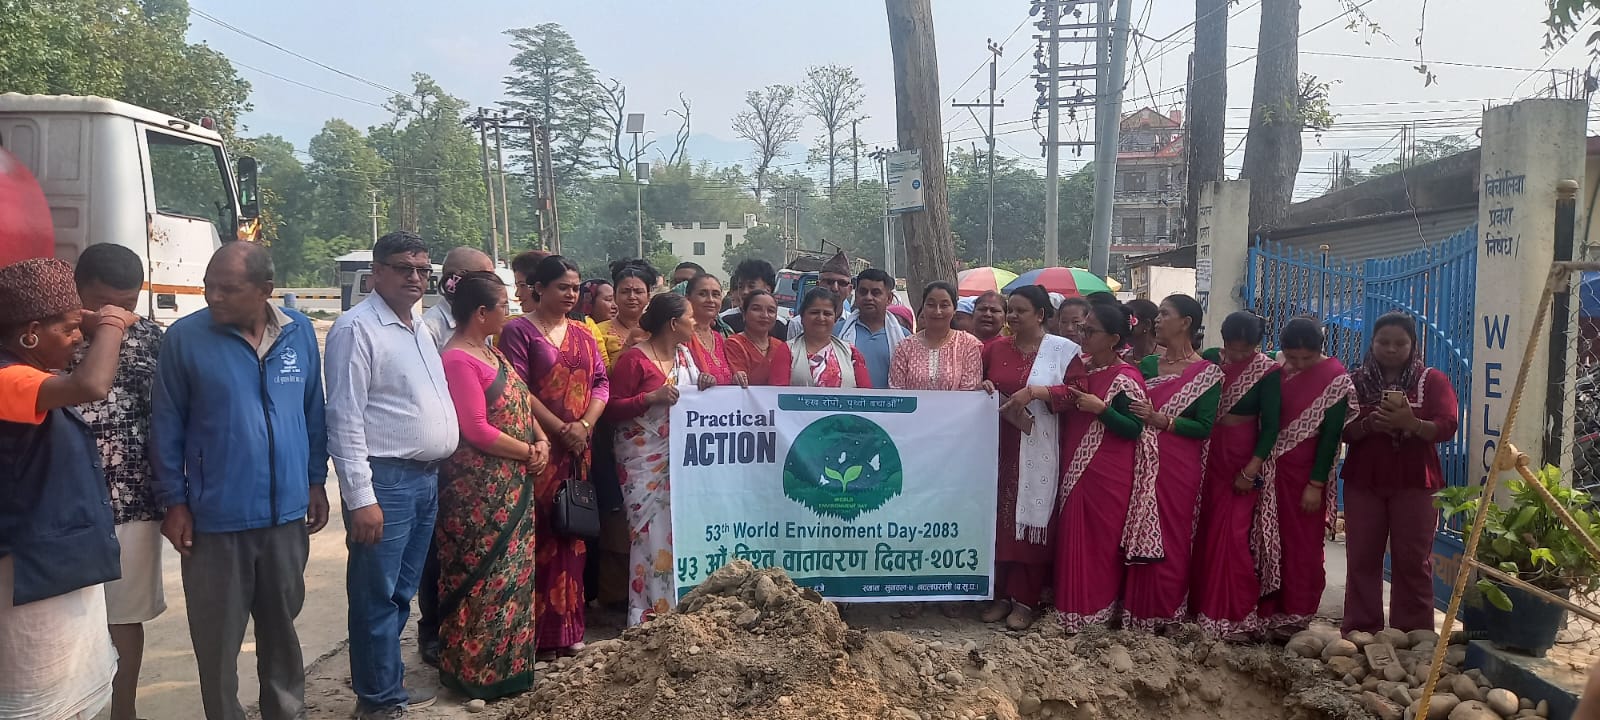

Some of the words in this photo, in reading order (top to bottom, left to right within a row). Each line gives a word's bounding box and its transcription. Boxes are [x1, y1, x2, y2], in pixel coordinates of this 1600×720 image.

[686, 409, 775, 428] Practical
[682, 431, 776, 467] ACTION
[705, 522, 730, 542] 53th
[733, 521, 779, 539] World
[785, 521, 882, 539] Envinoment
[887, 521, 959, 543] Day-2083
[677, 556, 698, 581] ५३
[782, 550, 868, 573] वातावरण
